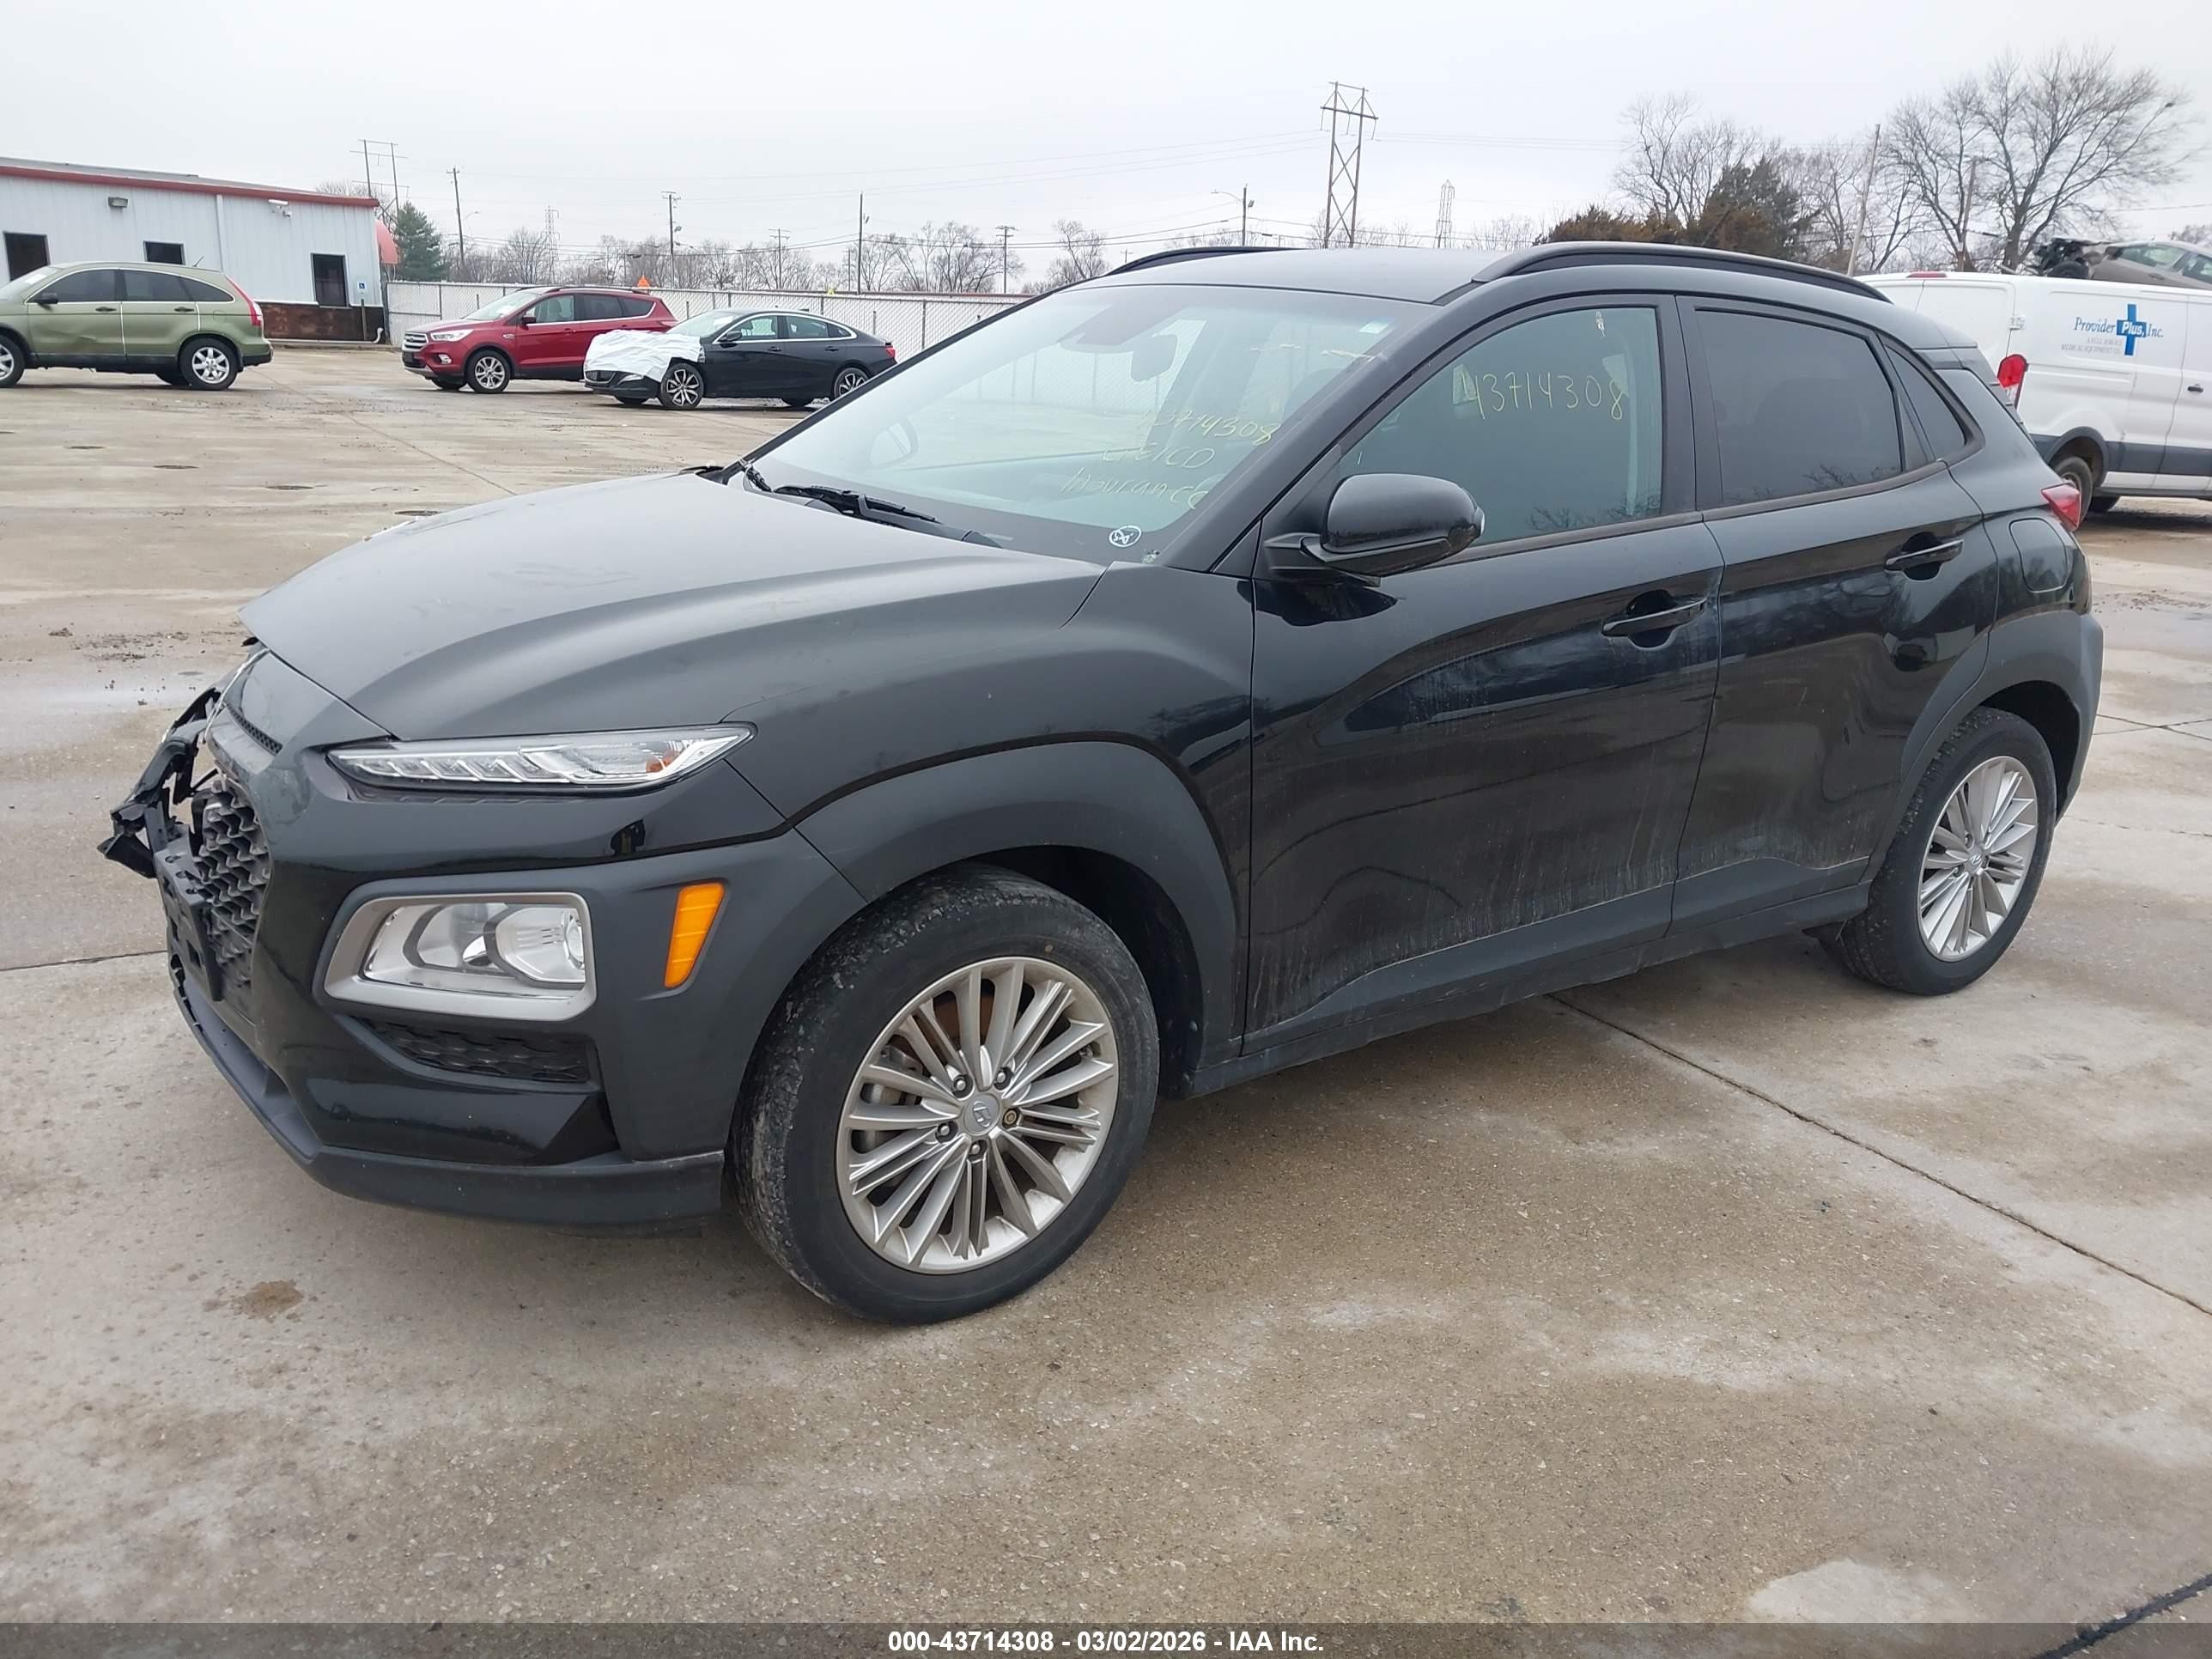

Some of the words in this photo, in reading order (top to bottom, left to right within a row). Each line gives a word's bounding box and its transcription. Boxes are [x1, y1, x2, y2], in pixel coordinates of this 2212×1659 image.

[2075, 317, 2116, 333] Provider
[2122, 322, 2145, 336] Plus,
[2147, 323, 2164, 337] Inc.
[1462, 371, 1623, 419] 43714308
